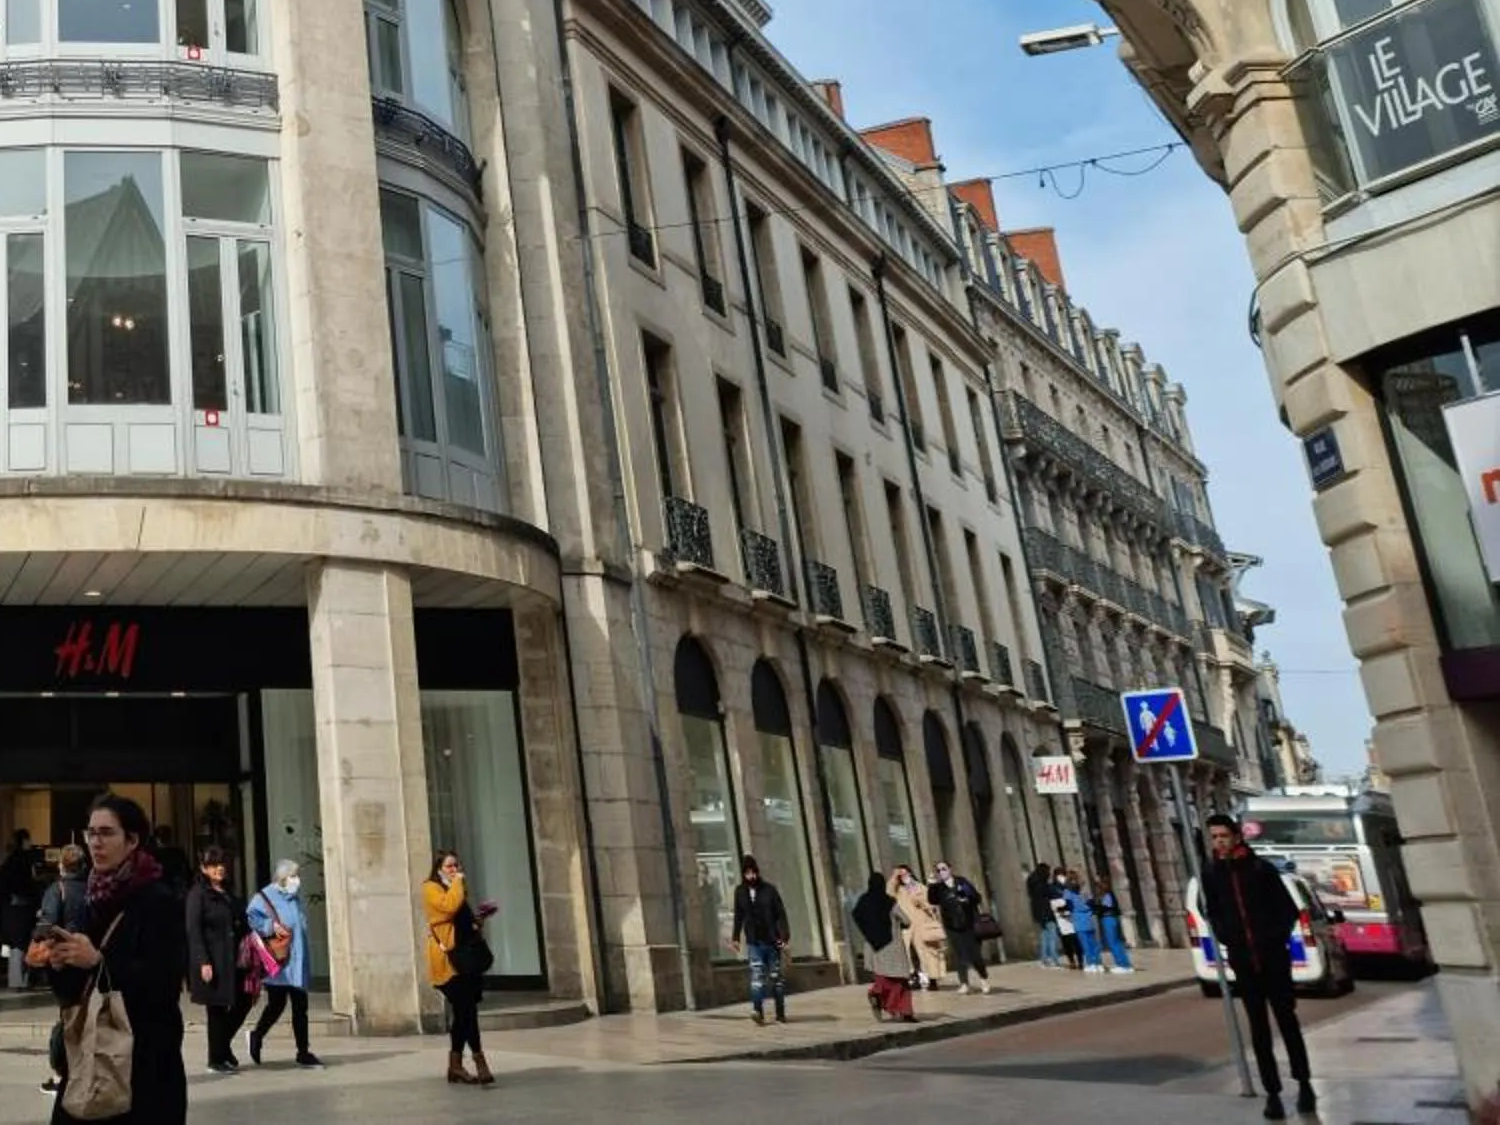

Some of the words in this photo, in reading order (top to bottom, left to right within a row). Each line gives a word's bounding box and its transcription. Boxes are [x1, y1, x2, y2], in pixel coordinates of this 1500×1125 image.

[1368, 36, 1402, 91] LE
[1354, 51, 1492, 137] VILLAGE
[54, 621, 139, 678] H&M
